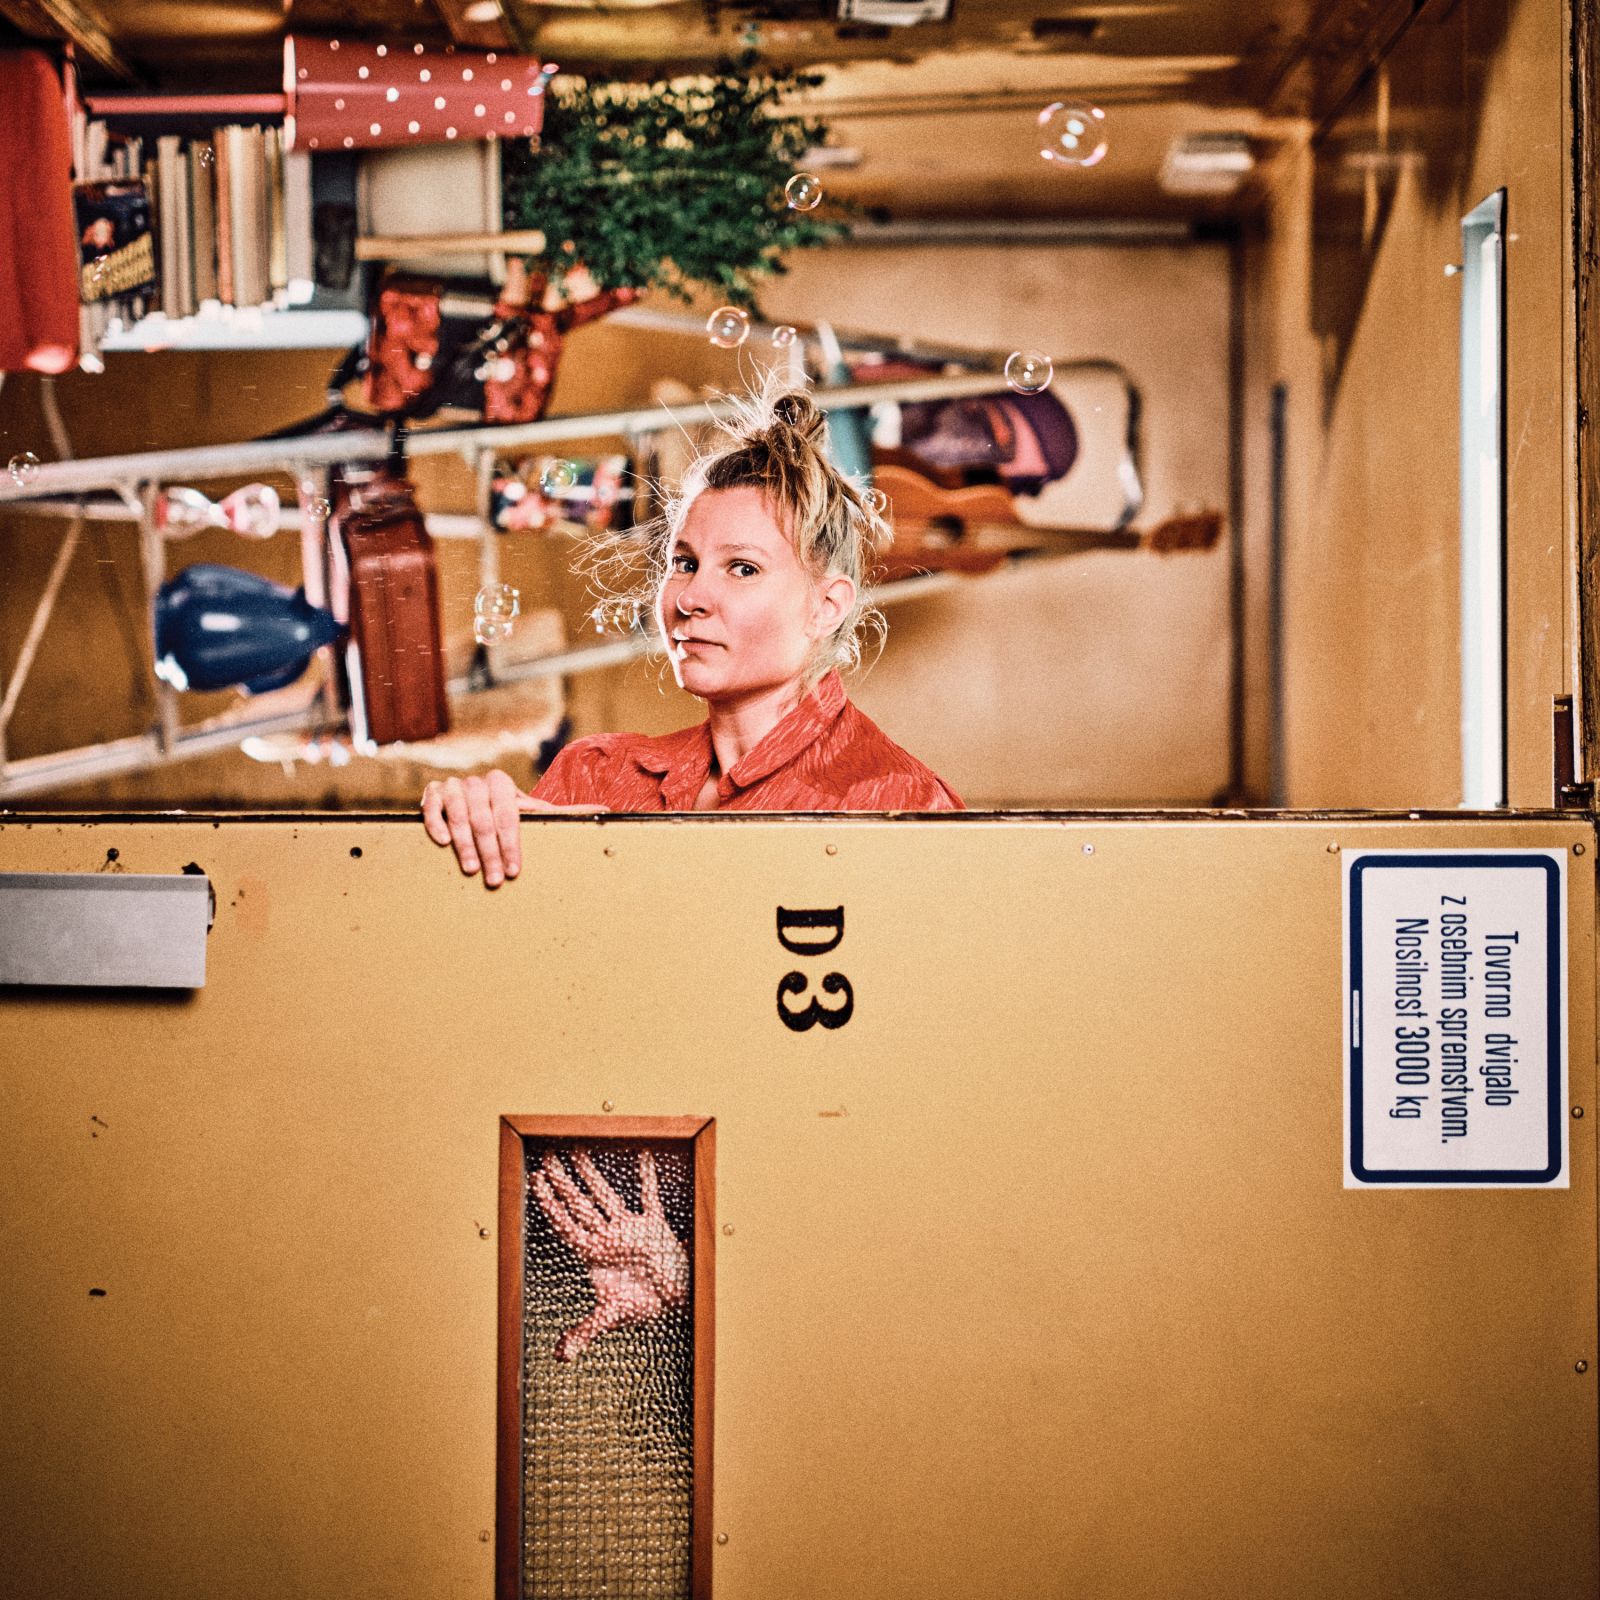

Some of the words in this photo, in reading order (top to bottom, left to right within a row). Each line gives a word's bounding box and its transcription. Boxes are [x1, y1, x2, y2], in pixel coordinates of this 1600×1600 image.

[776, 905, 855, 1033] D3
[1394, 918, 1430, 1019] Nosilnost
[1440, 913, 1474, 1000] osebnim
[1484, 930, 1519, 1018] Tovorno
[1394, 1026, 1431, 1086] 3000
[1435, 1007, 1475, 1144] spremstvom.
[1478, 1033, 1520, 1107] dvigalo
[1388, 1095, 1430, 1119] kg
